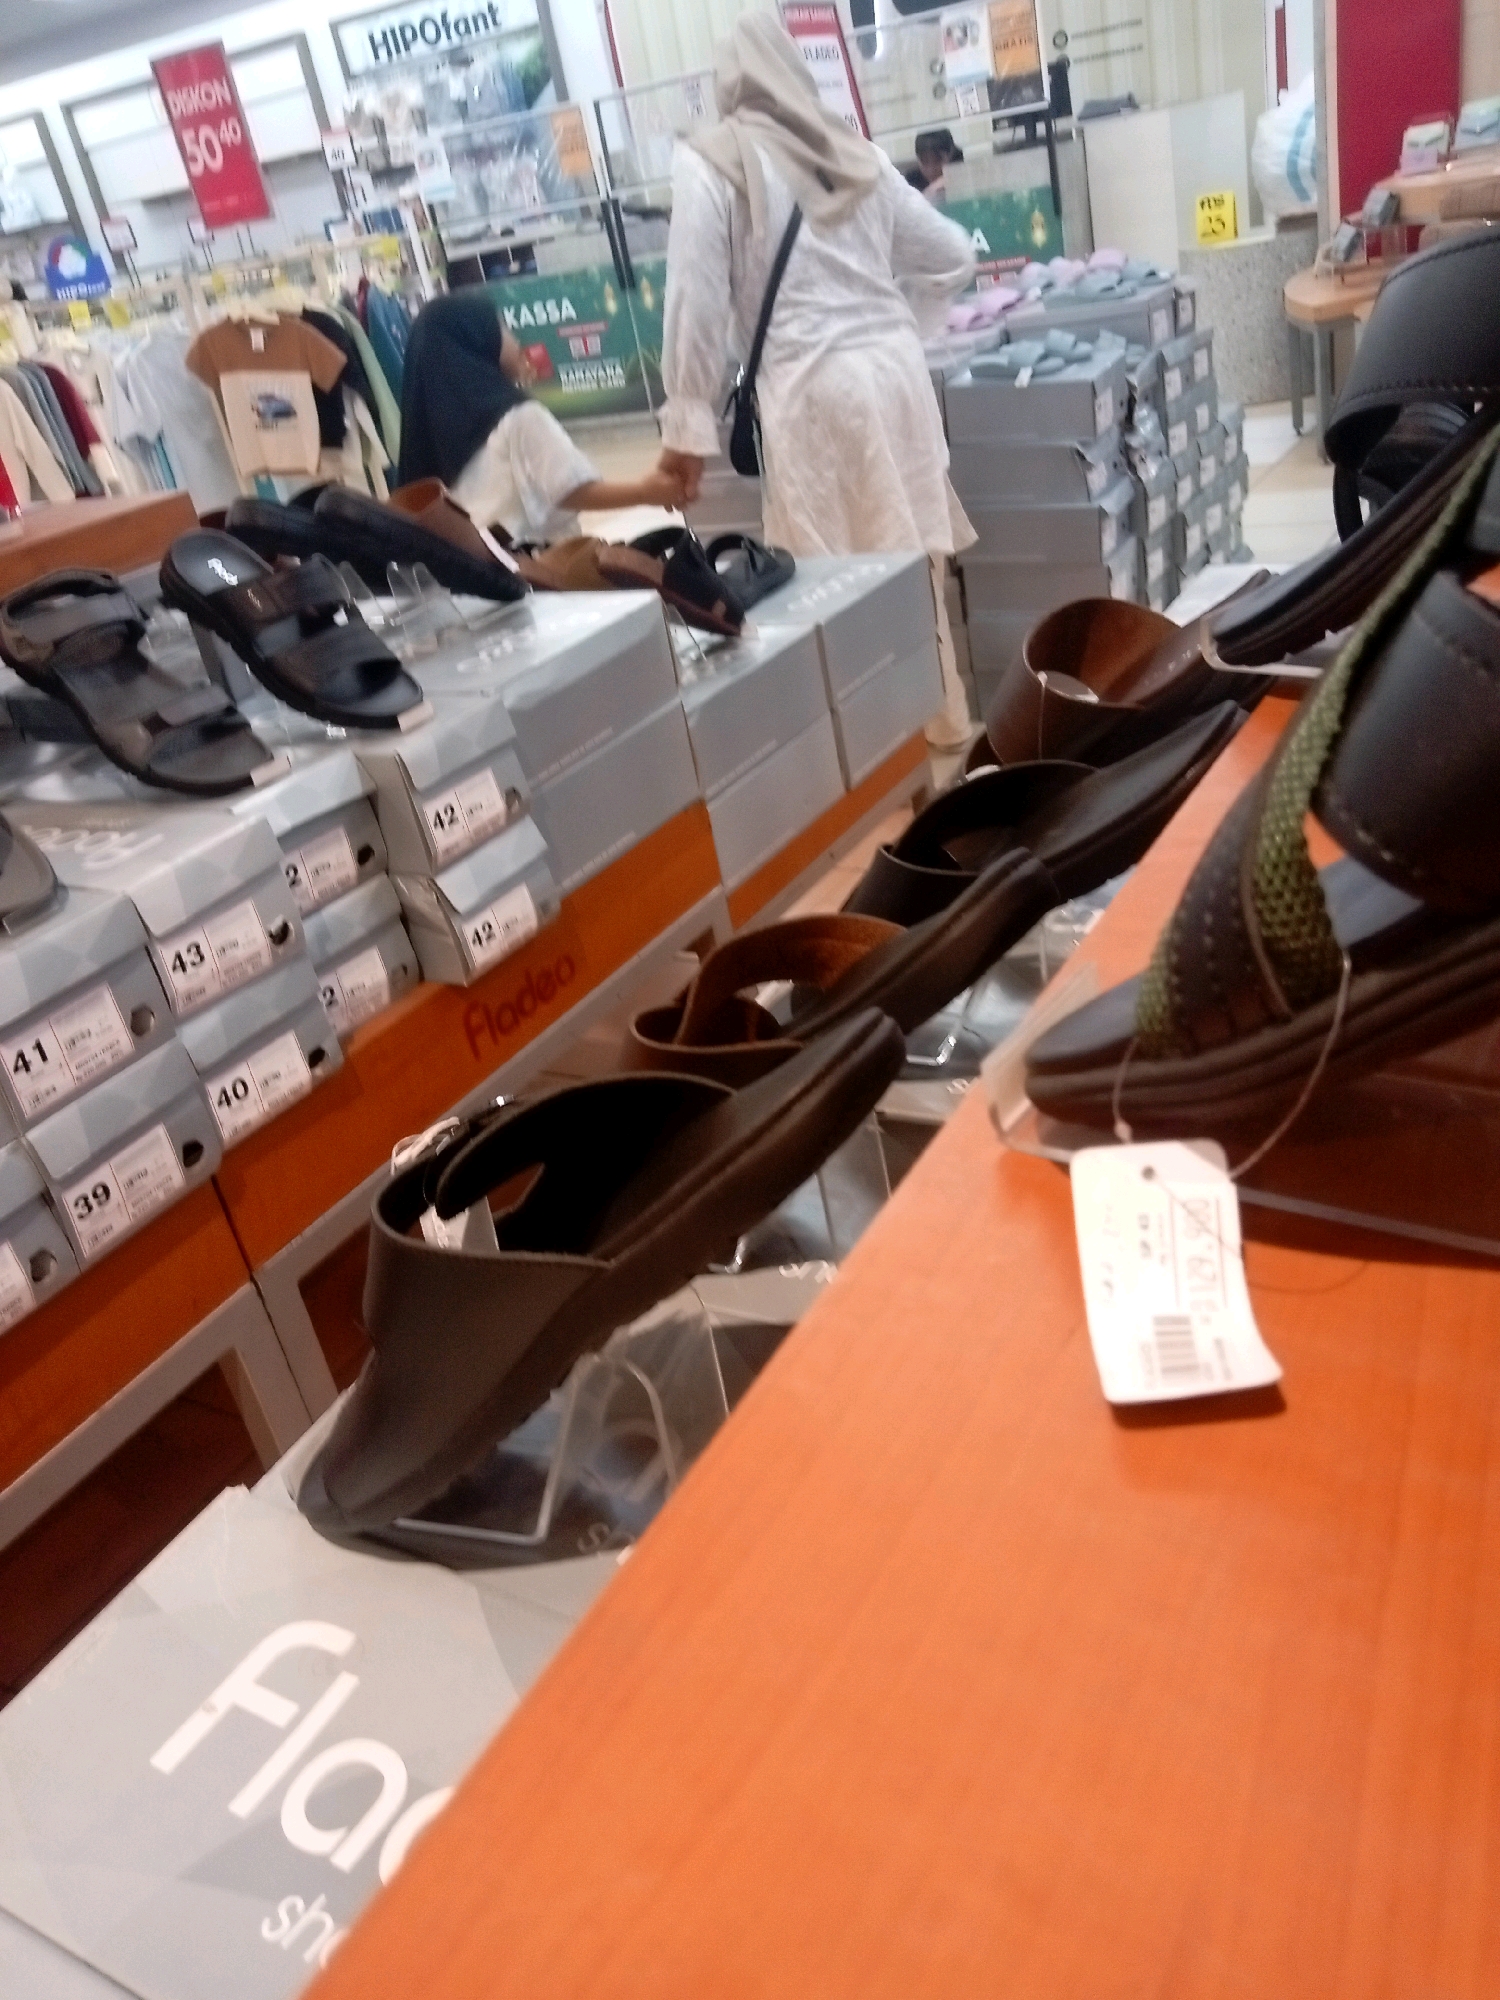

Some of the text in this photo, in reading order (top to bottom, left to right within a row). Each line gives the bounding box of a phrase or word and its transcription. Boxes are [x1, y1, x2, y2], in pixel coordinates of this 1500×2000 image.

[367, 2, 500, 62] HIPOfant
[166, 76, 233, 120] DISKON
[503, 297, 577, 330] KASSA
[433, 802, 460, 831] 42
[286, 863, 302, 888] 2
[471, 919, 496, 948] 42
[172, 940, 205, 974] 43
[322, 985, 339, 1008] 2
[13, 1037, 49, 1074] 41
[217, 1075, 249, 1109] 40
[73, 1181, 111, 1220] 39
